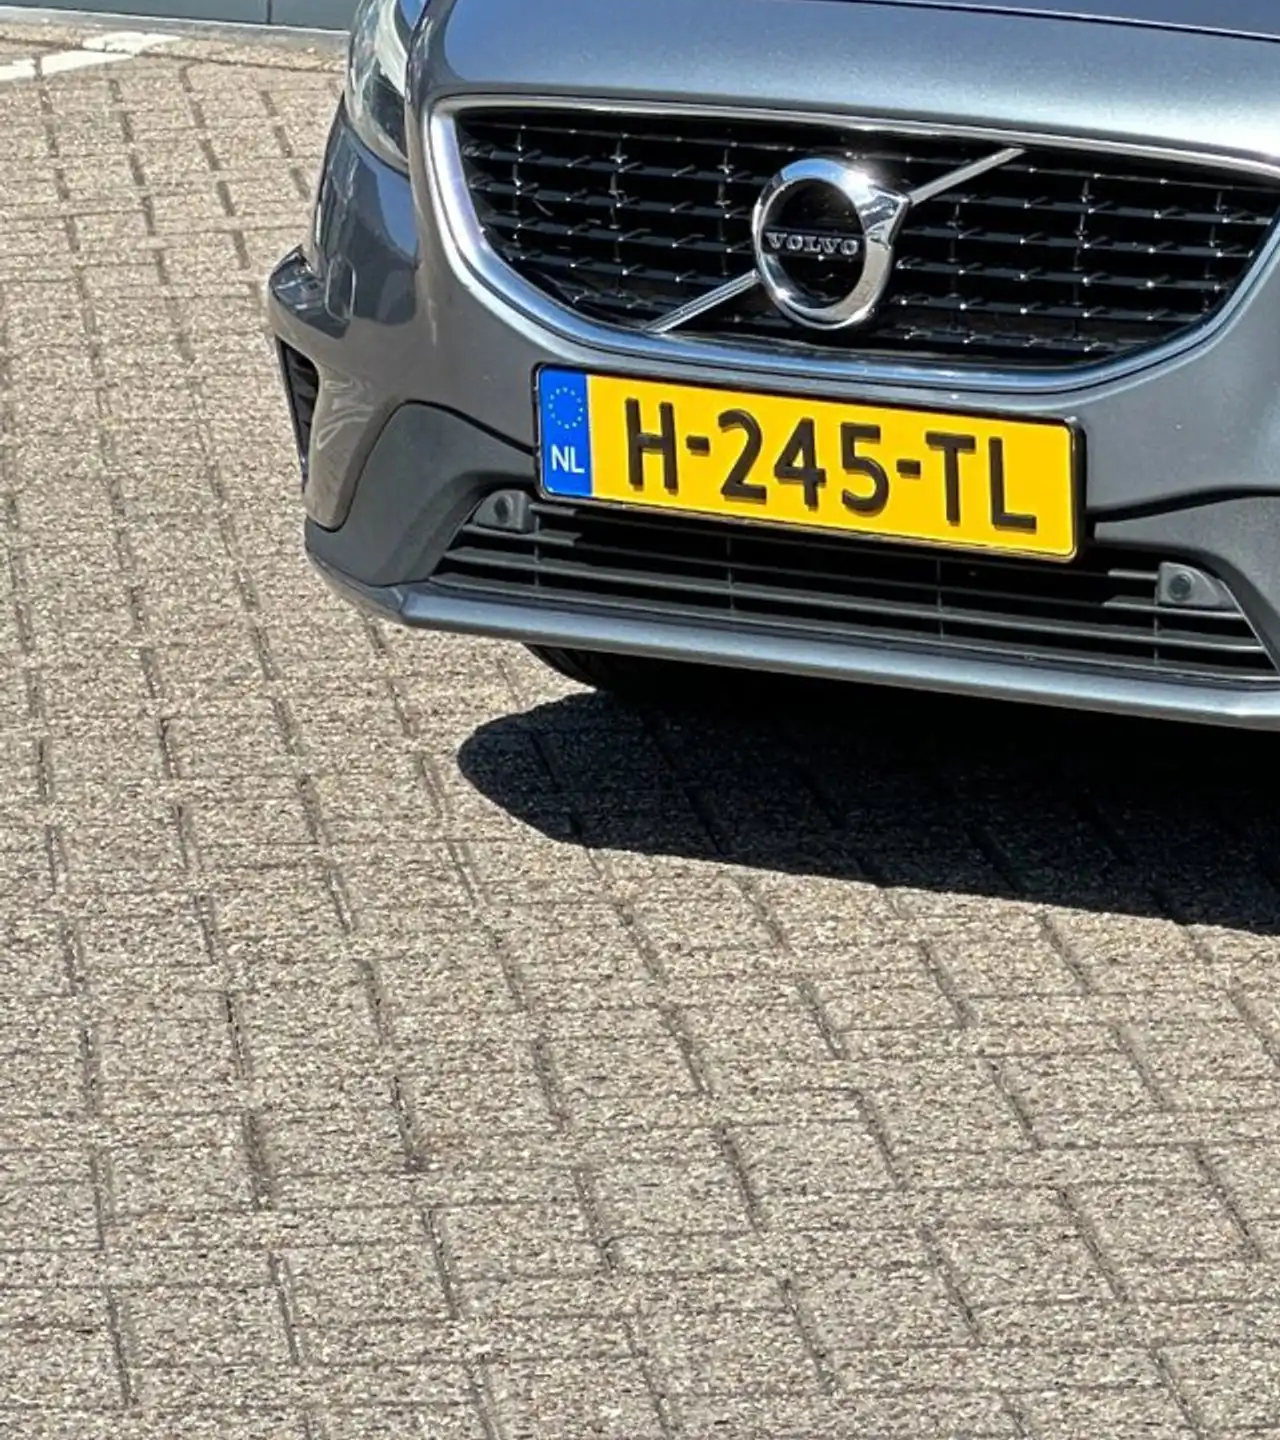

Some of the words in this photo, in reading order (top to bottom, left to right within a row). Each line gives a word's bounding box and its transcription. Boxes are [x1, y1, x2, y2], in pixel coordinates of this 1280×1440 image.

[765, 231, 859, 256] VOLVO
[551, 445, 585, 474] NL
[624, 397, 1038, 533] H-245-TL
